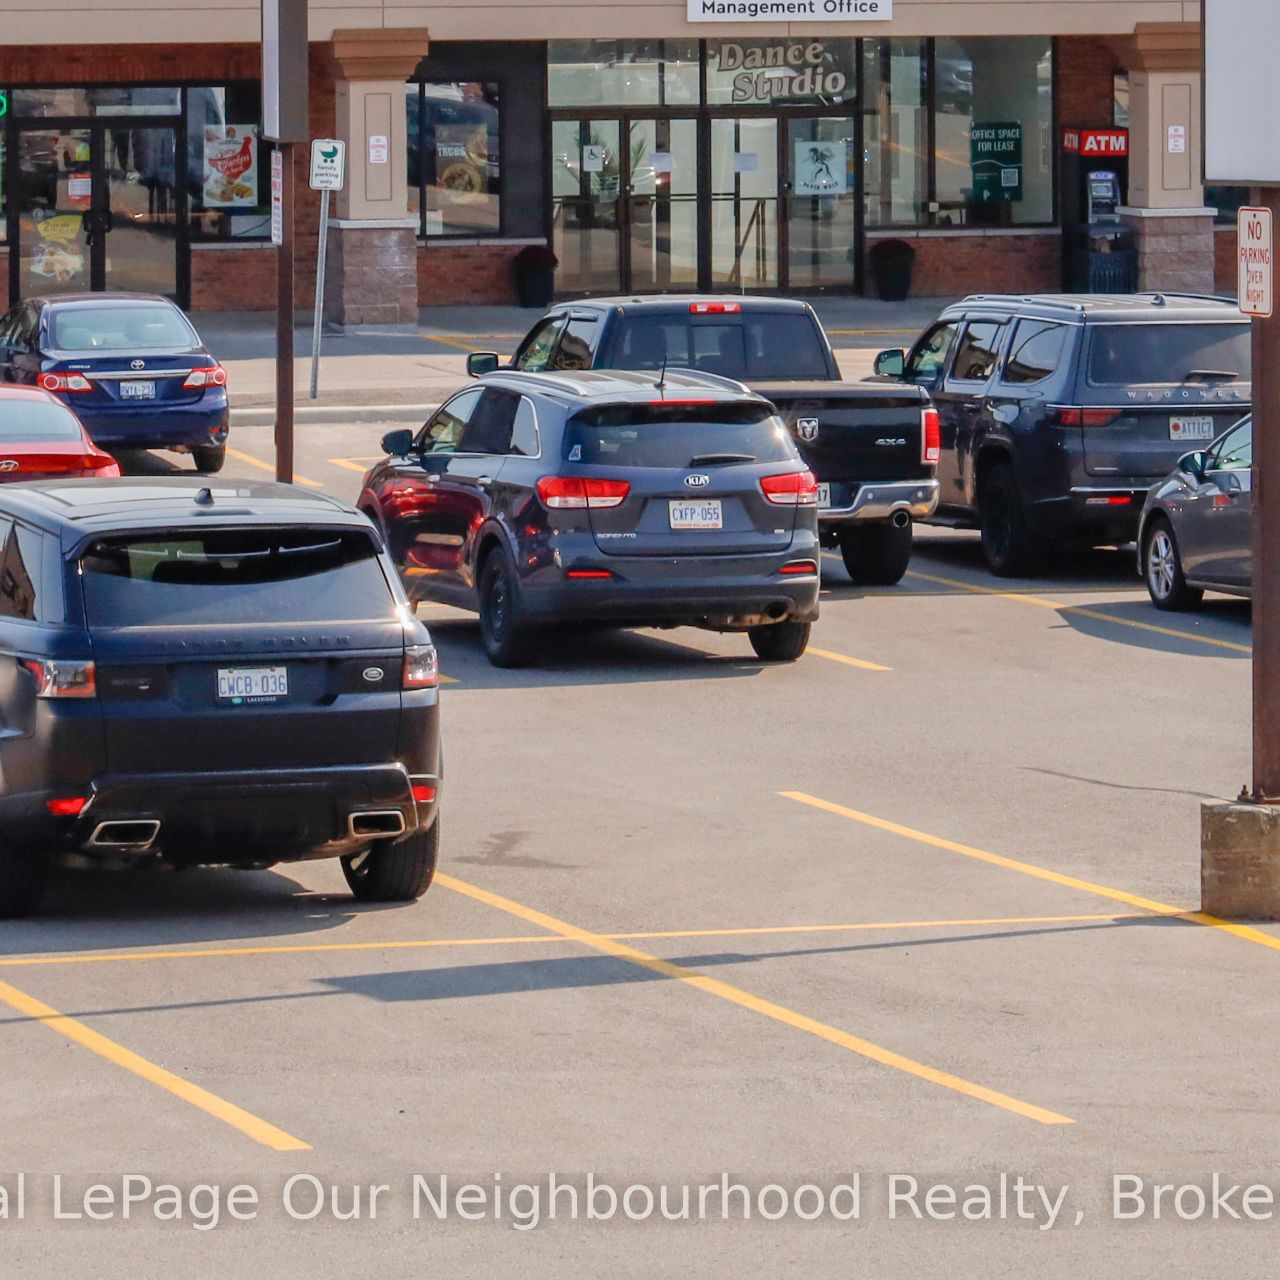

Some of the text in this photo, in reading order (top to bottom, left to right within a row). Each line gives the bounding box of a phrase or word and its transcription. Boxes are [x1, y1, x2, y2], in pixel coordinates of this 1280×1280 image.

[701, 0, 815, 17] Management
[718, 42, 825, 72] Dance
[732, 67, 846, 102] Studio
[972, 128, 1020, 140] OFFICE SPACE
[1063, 132, 1079, 149] ATM
[977, 141, 1015, 152] FOR LEASE
[1083, 135, 1126, 151] ATM
[437, 146, 466, 158] TACOS
[1247, 220, 1262, 241] NO
[1240, 247, 1270, 265] PARKING
[1247, 270, 1264, 284] OVER
[1247, 289, 1265, 303] NIGHT
[1127, 390, 1240, 398] WAGONEE
[688, 476, 706, 485] KIA
